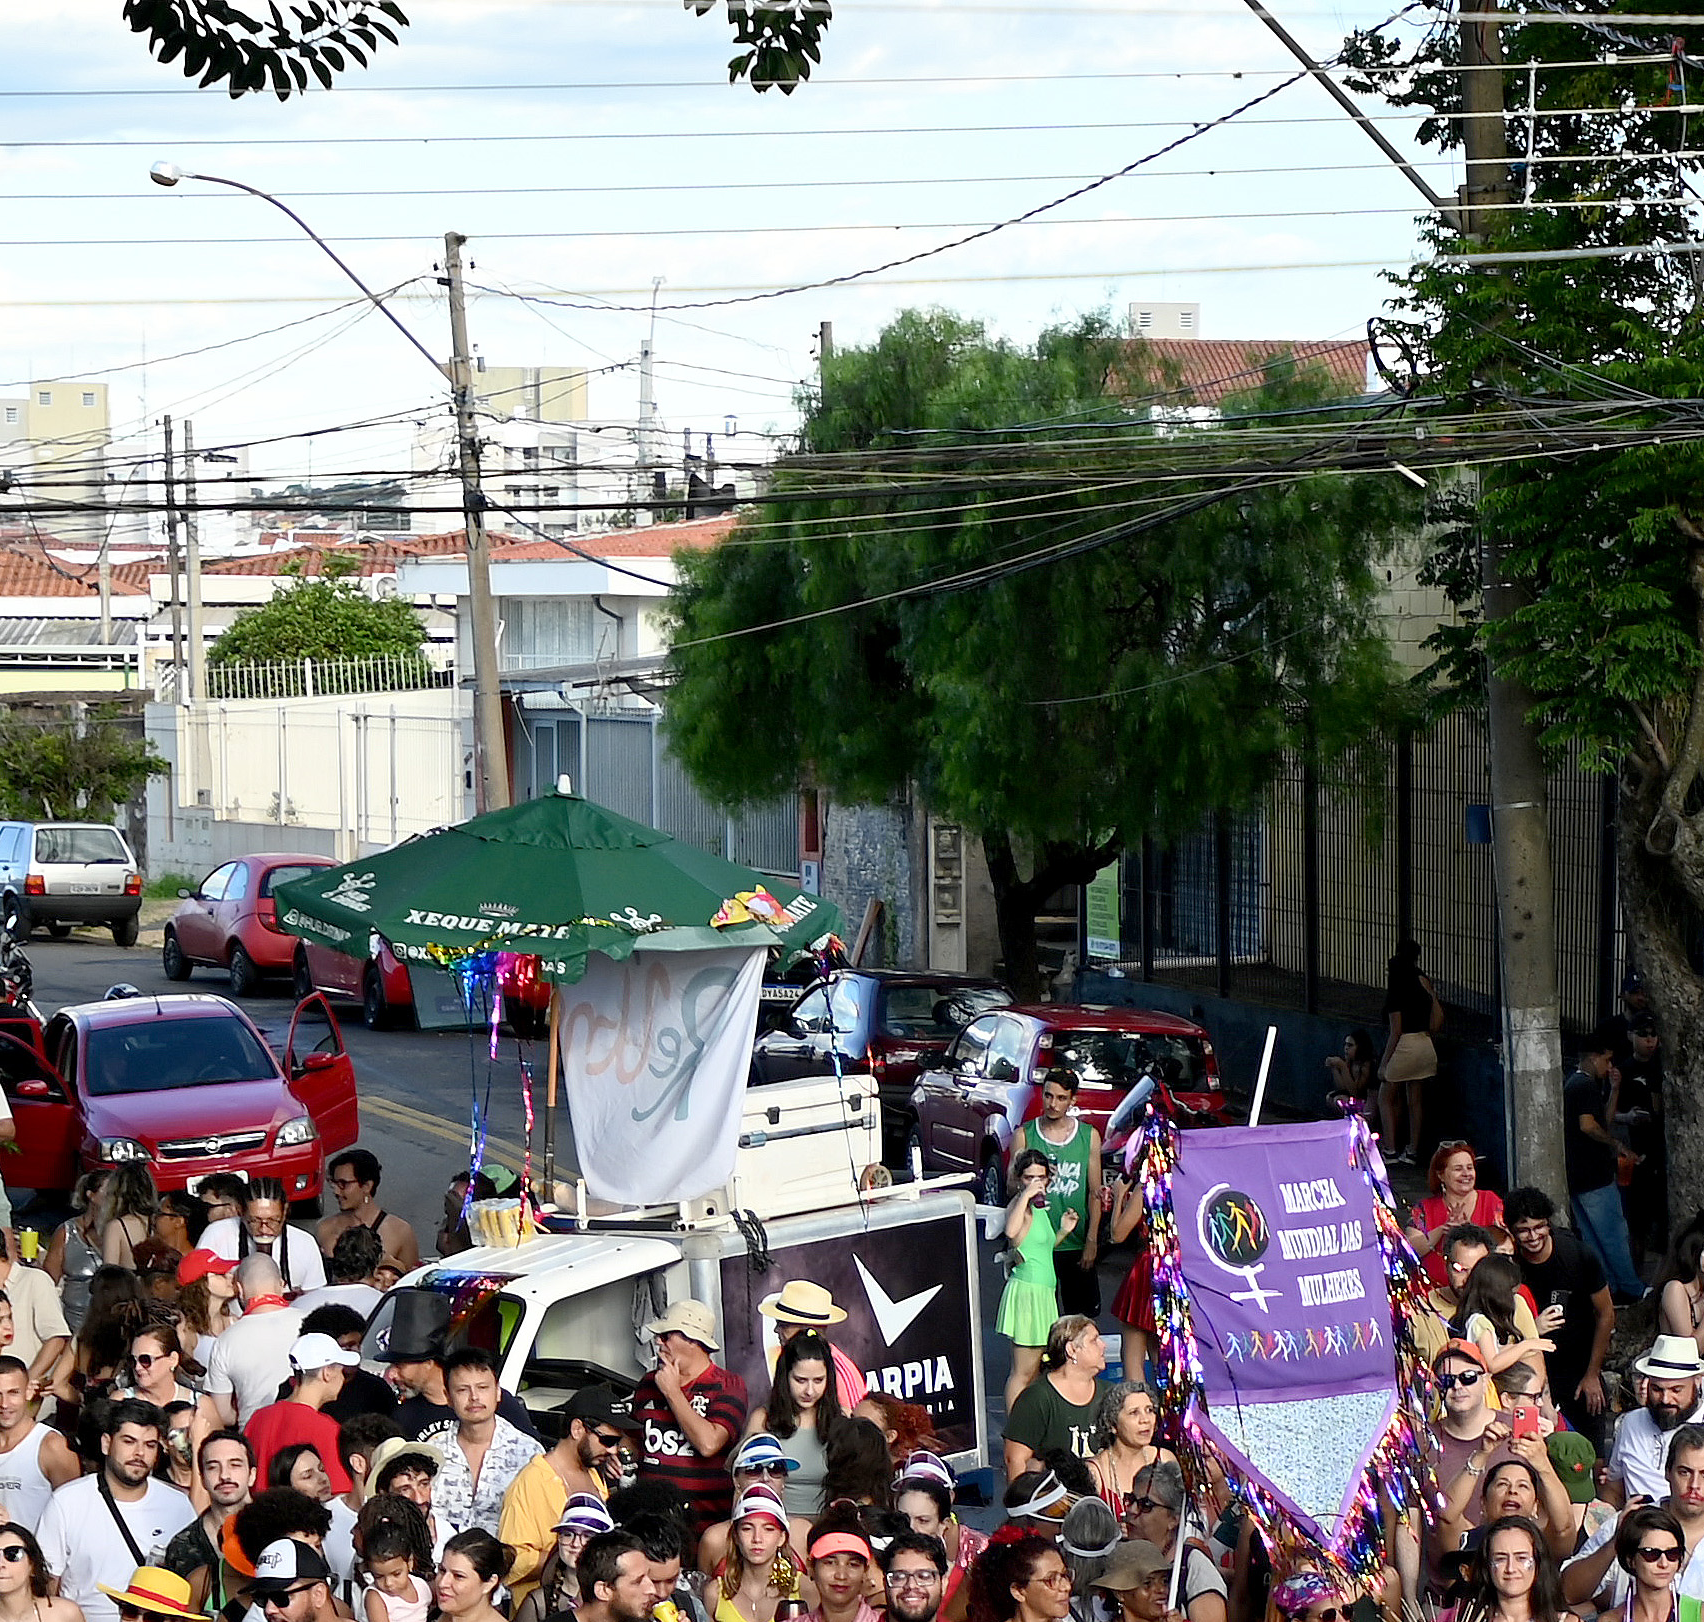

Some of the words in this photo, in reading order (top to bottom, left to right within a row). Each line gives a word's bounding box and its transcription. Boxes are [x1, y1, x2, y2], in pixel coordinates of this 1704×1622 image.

[403, 908, 494, 933] XEQUE
[1279, 1177, 1347, 1214] MARCHA
[1276, 1224, 1340, 1260] MUNDIAL
[1340, 1219, 1363, 1253] DAS
[1296, 1267, 1366, 1307] MULHERES
